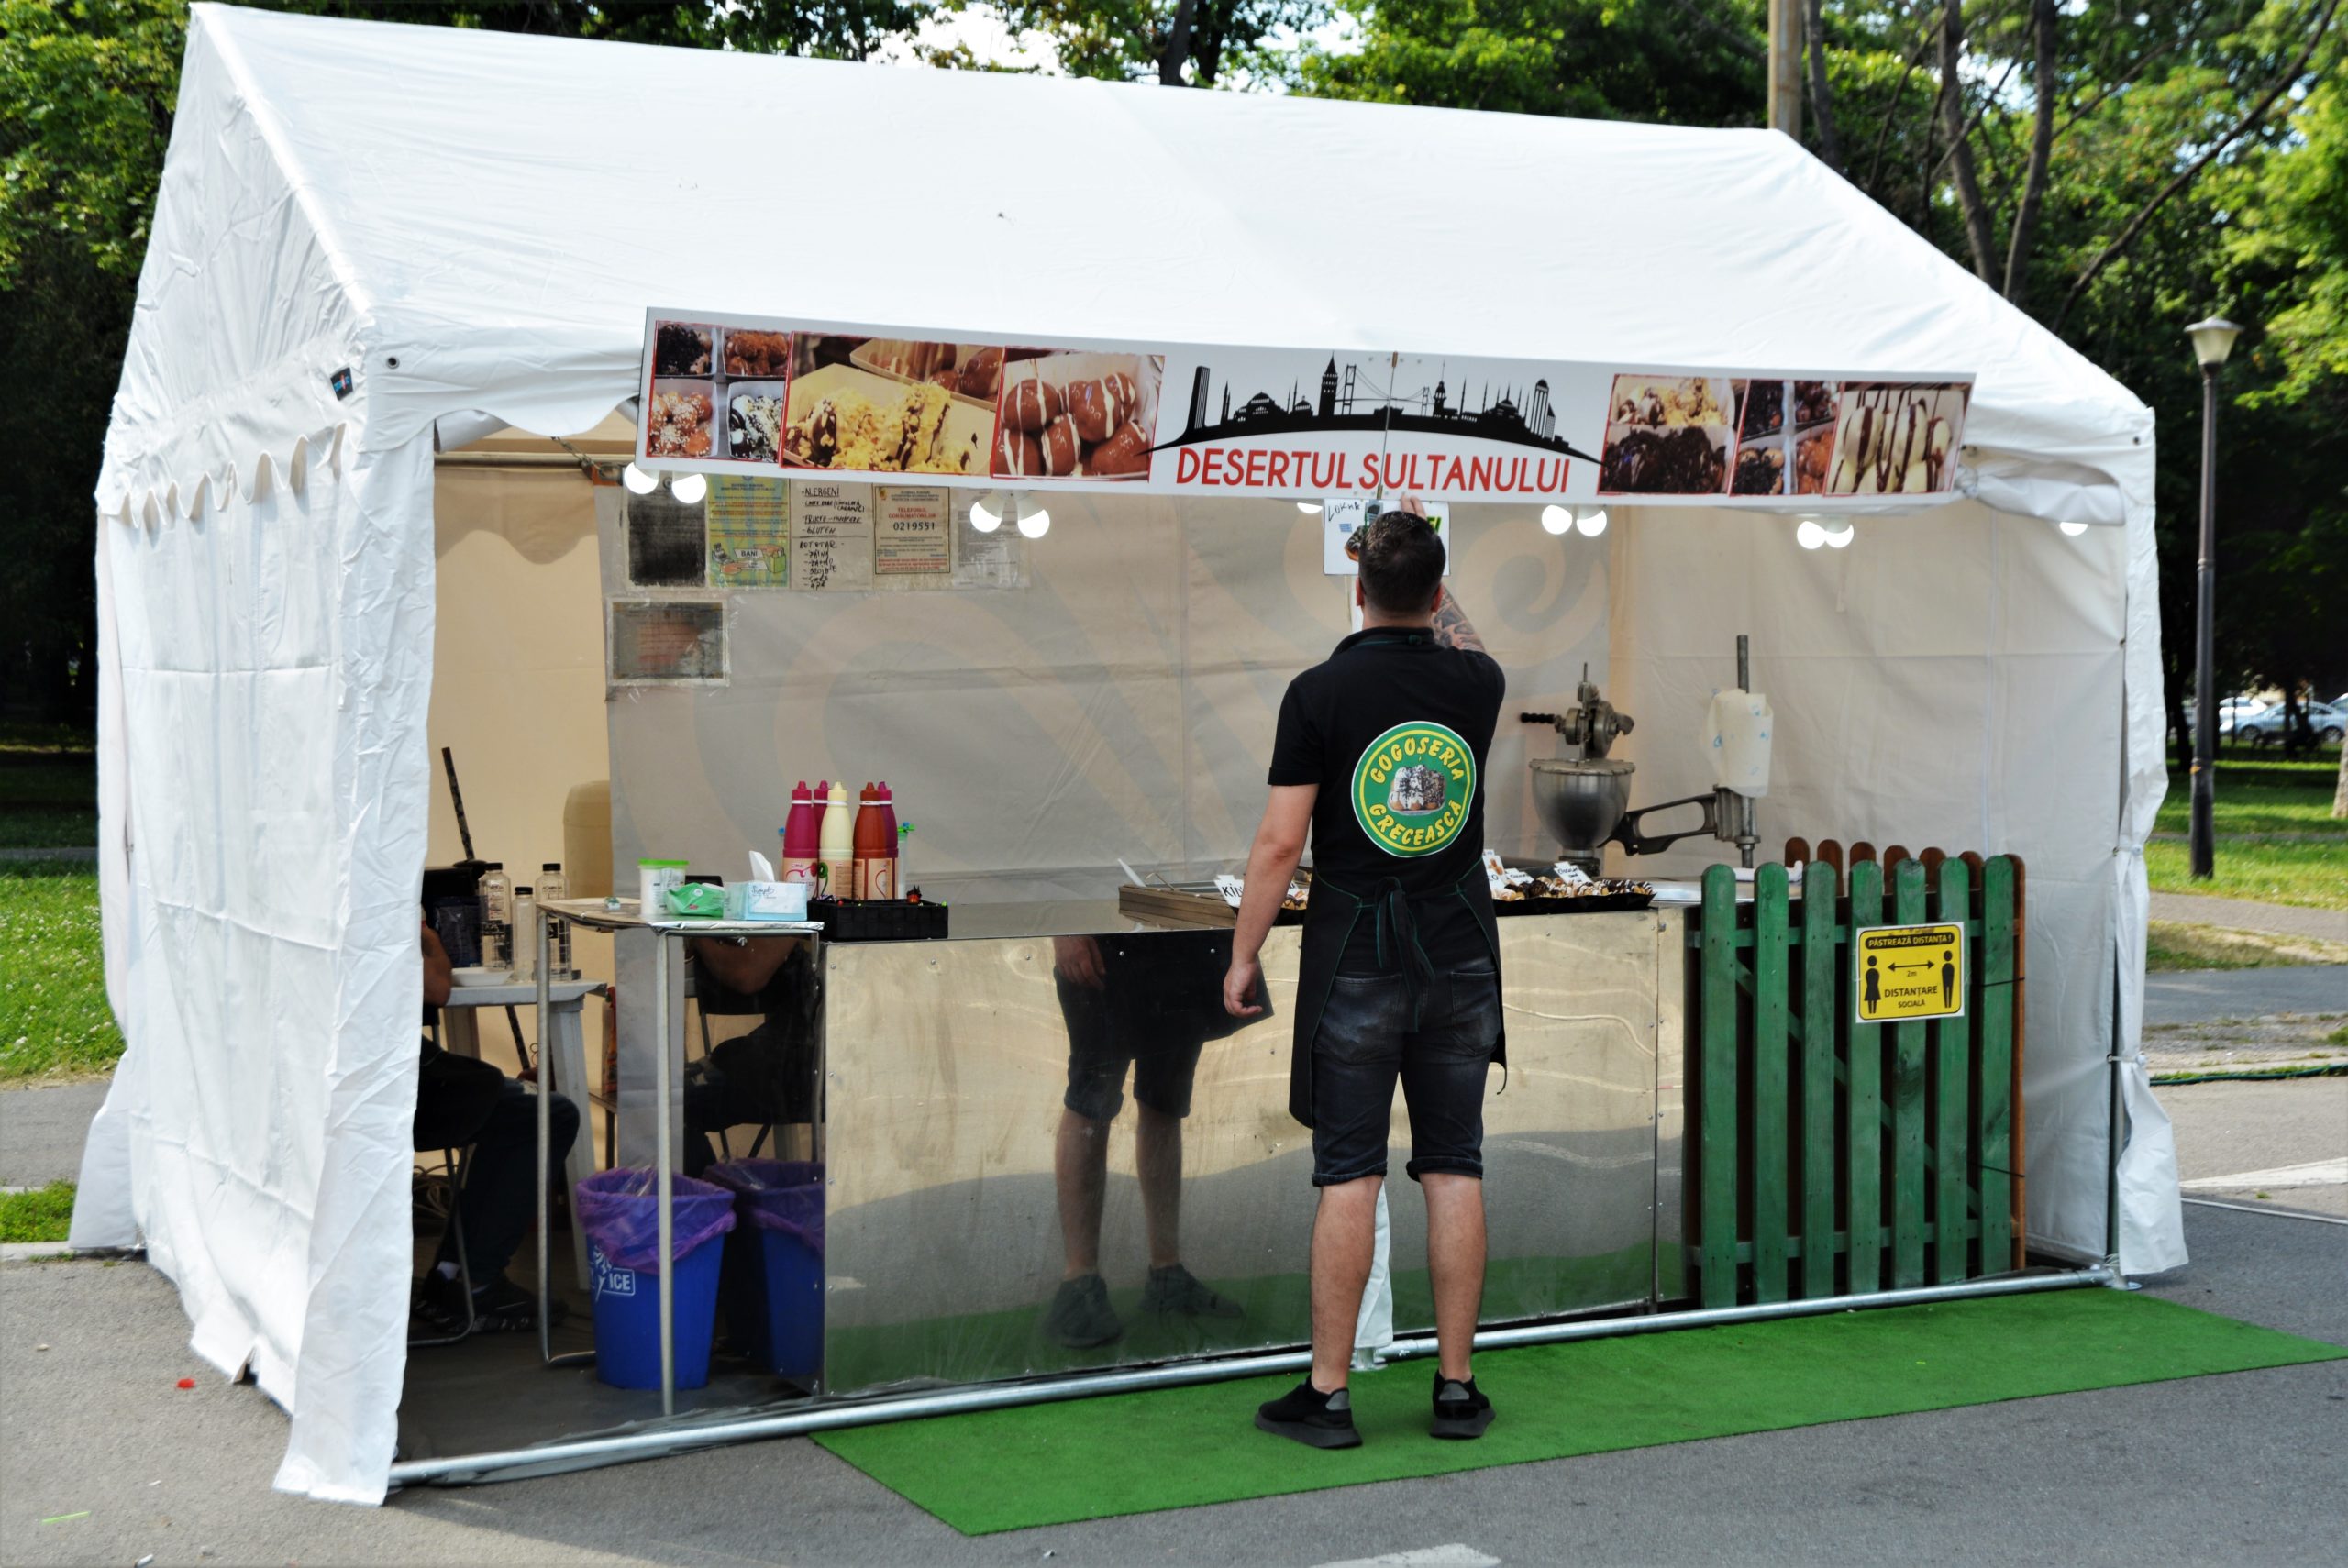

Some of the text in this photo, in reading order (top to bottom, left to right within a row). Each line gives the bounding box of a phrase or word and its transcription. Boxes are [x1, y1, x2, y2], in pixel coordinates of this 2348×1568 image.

[1176, 447, 1571, 493] DESERTUL SULTANULUI
[892, 522, 935, 531] 0219551
